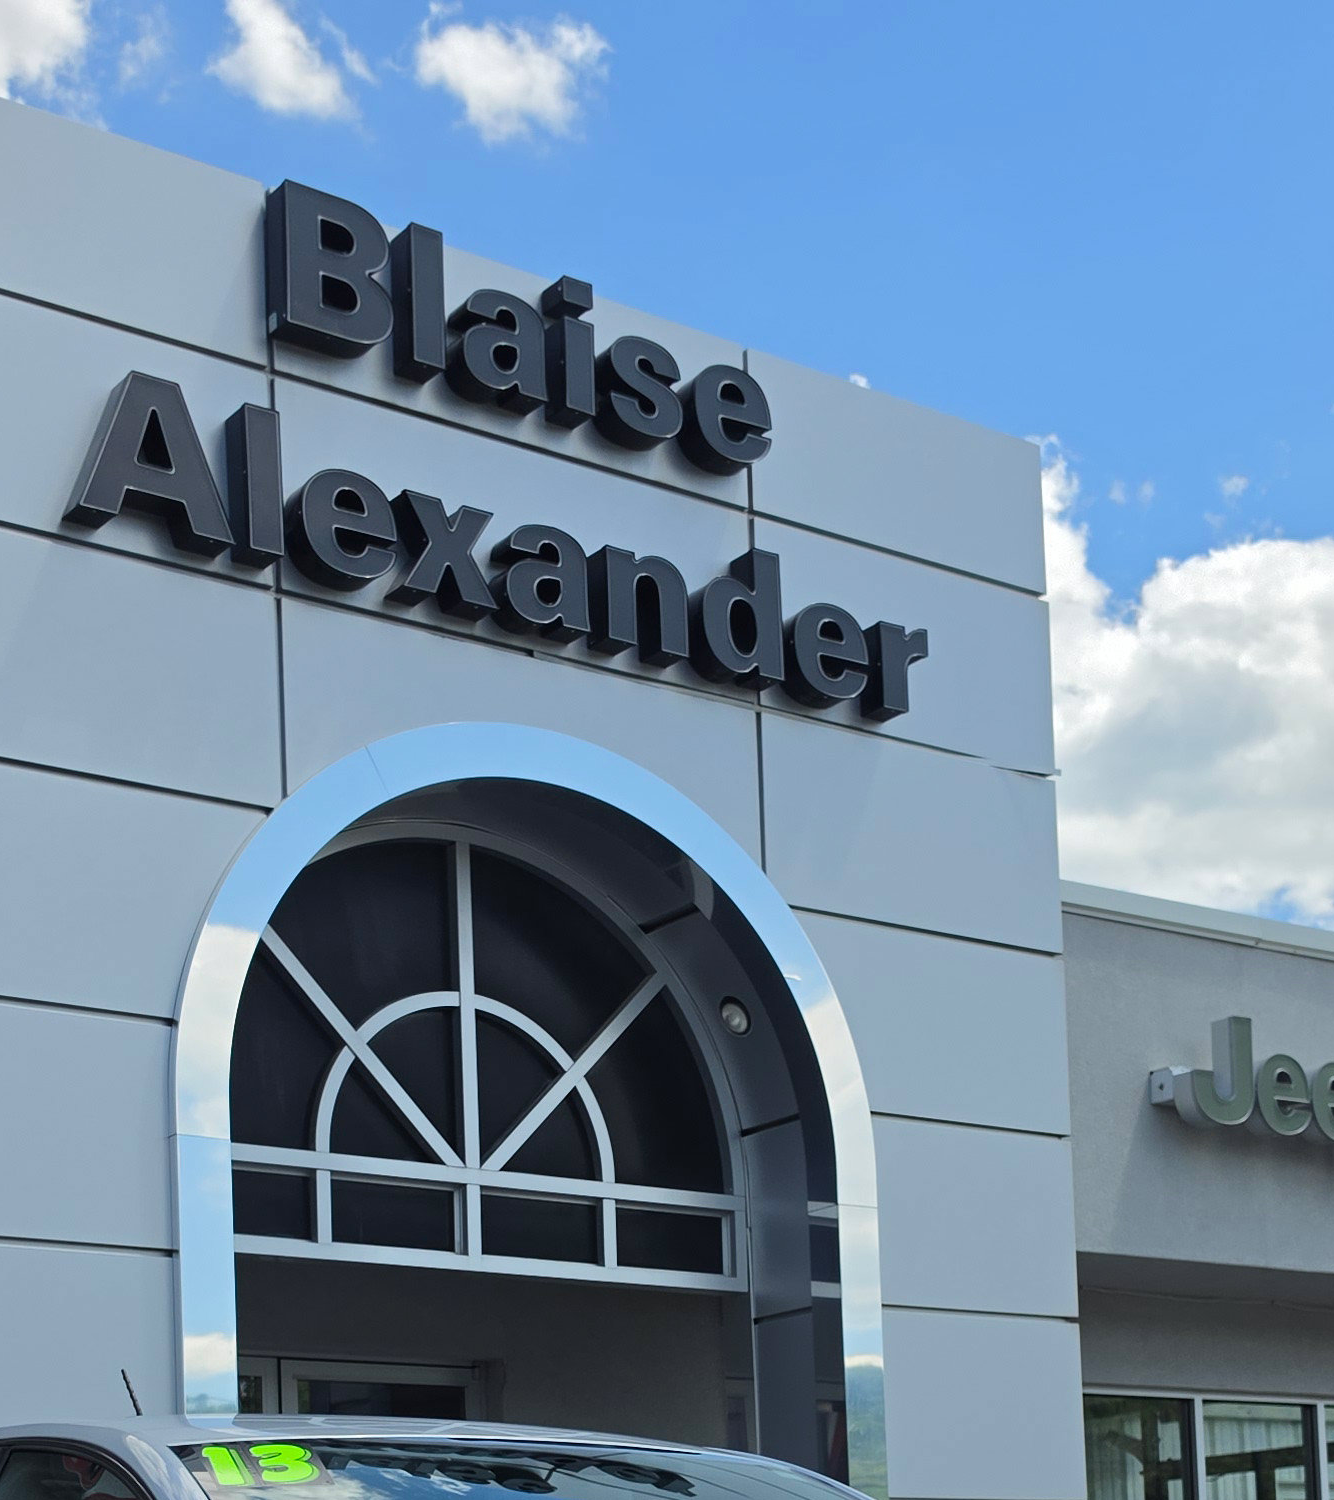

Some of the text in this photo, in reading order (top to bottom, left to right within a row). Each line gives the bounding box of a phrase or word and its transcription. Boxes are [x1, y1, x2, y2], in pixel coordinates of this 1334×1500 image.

[268, 179, 772, 475] Blaise
[64, 371, 928, 722] Alexander
[202, 1443, 320, 1486] 13
